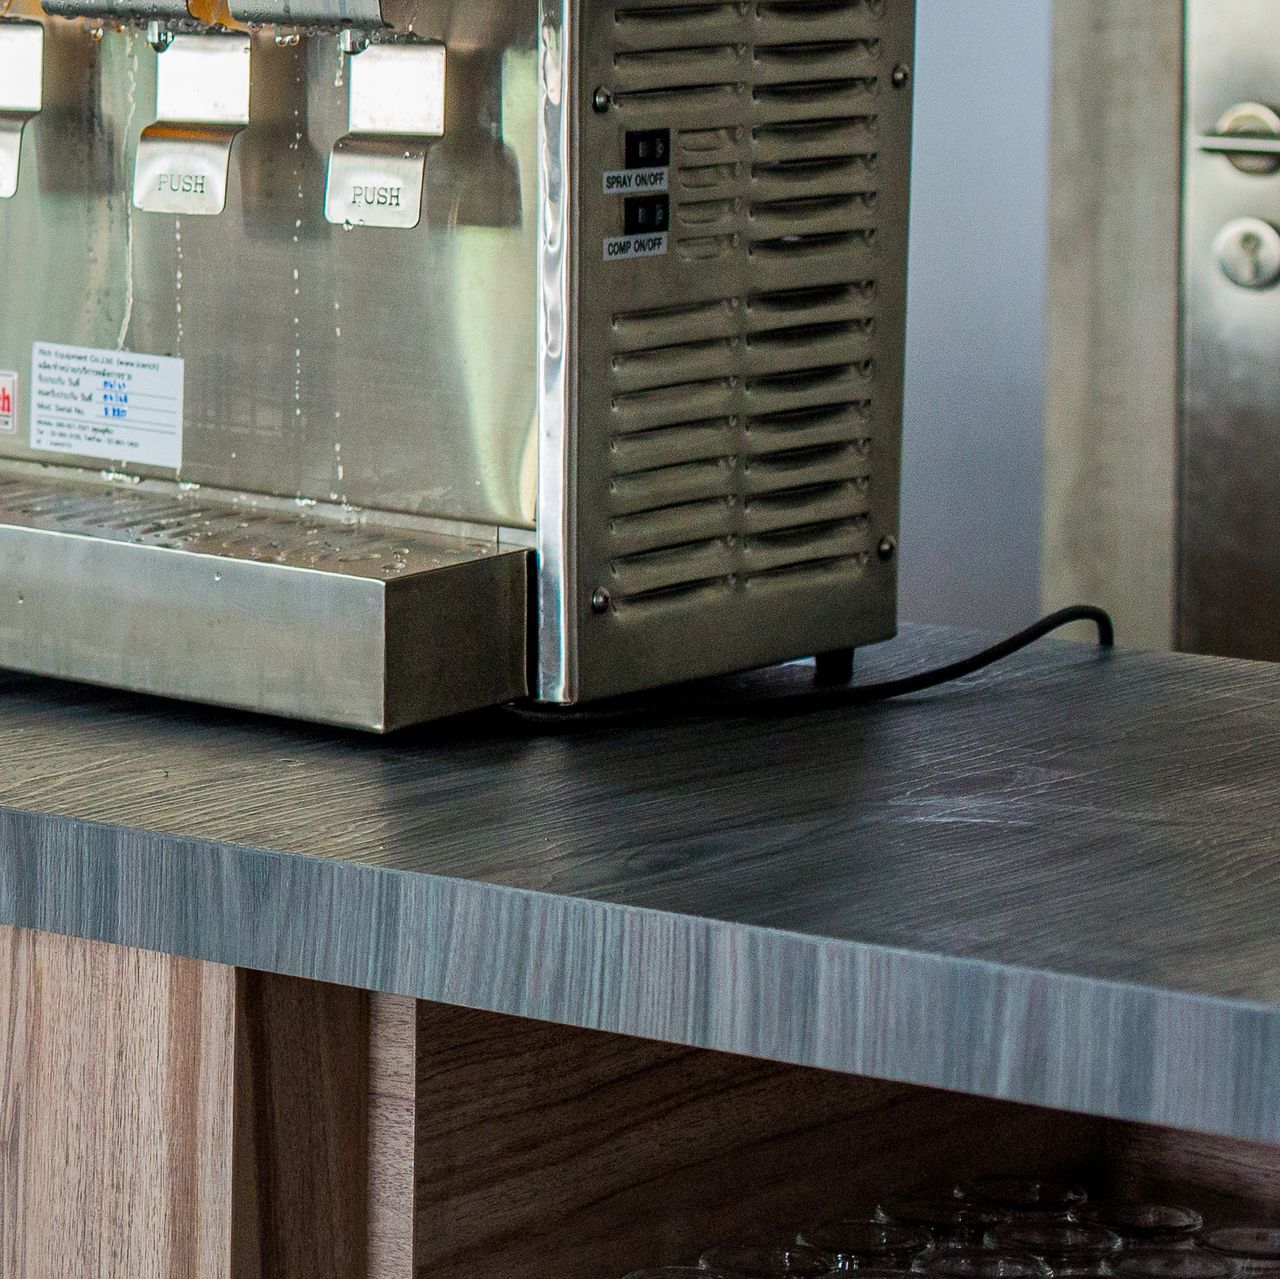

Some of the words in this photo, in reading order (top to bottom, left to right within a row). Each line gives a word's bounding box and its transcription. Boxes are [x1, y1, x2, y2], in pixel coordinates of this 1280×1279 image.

[157, 173, 206, 194] PUSH
[606, 174, 632, 189] SPRAY
[635, 172, 665, 187] ON/OFF
[351, 186, 401, 207] PUSH
[607, 241, 631, 255] COMP
[633, 237, 663, 253] ON/OFF
